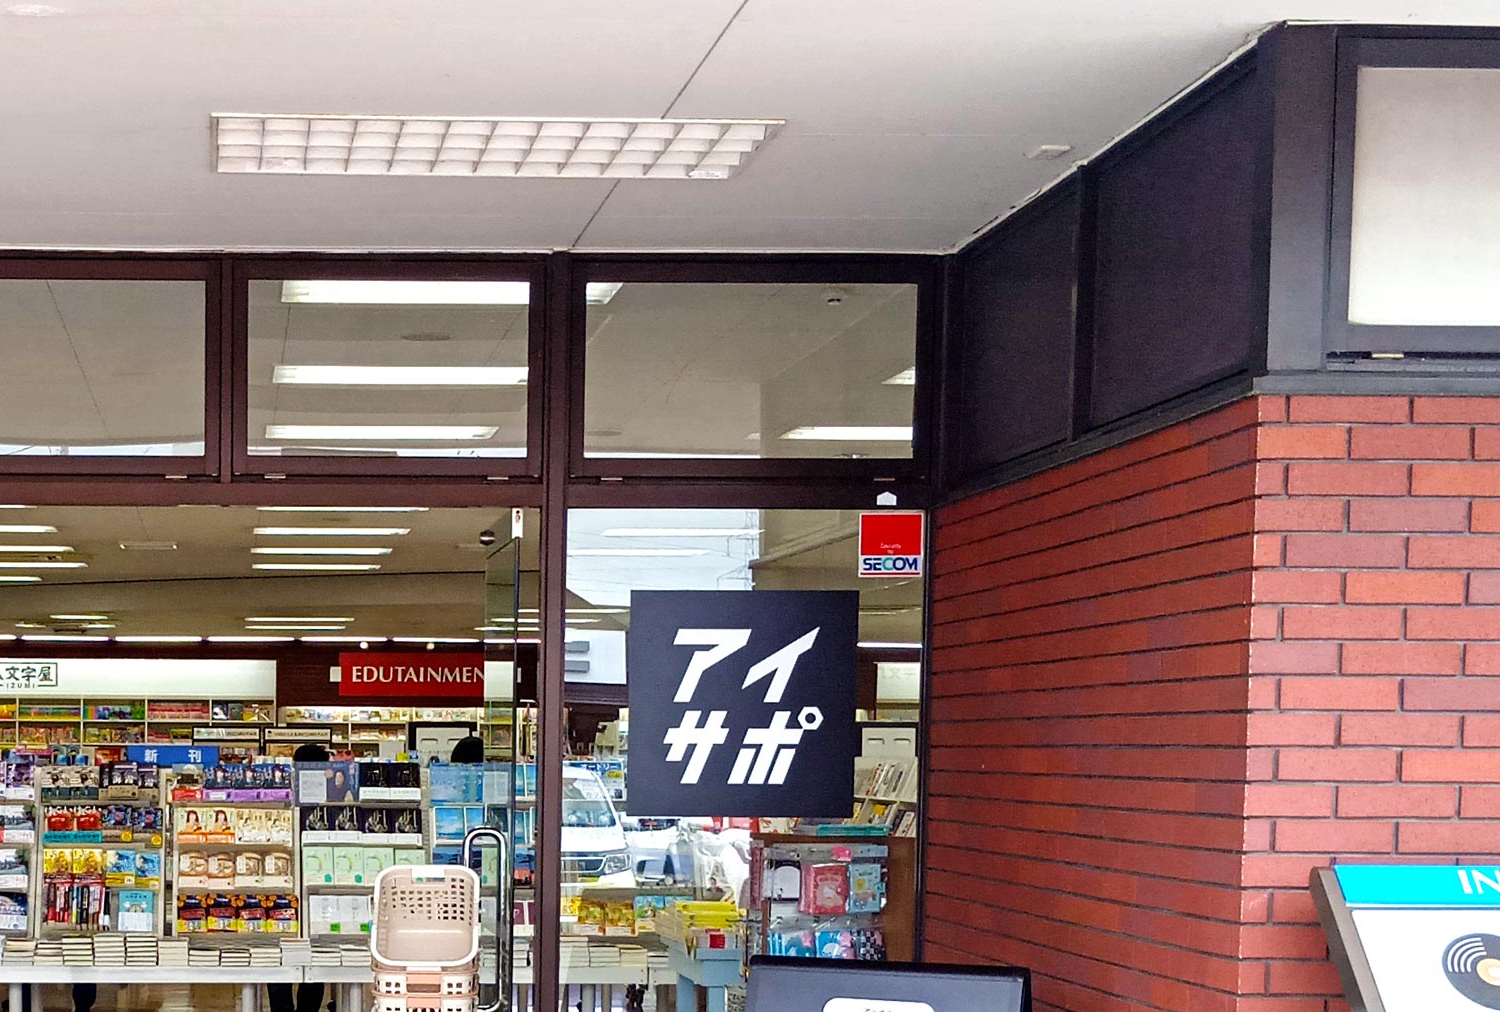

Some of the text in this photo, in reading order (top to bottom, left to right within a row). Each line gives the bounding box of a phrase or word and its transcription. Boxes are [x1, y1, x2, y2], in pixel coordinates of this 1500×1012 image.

[863, 557, 918, 571] SECOM
[673, 626, 820, 703] アイ
[144, 748, 202, 764] 新刊
[663, 706, 824, 785] サポ
